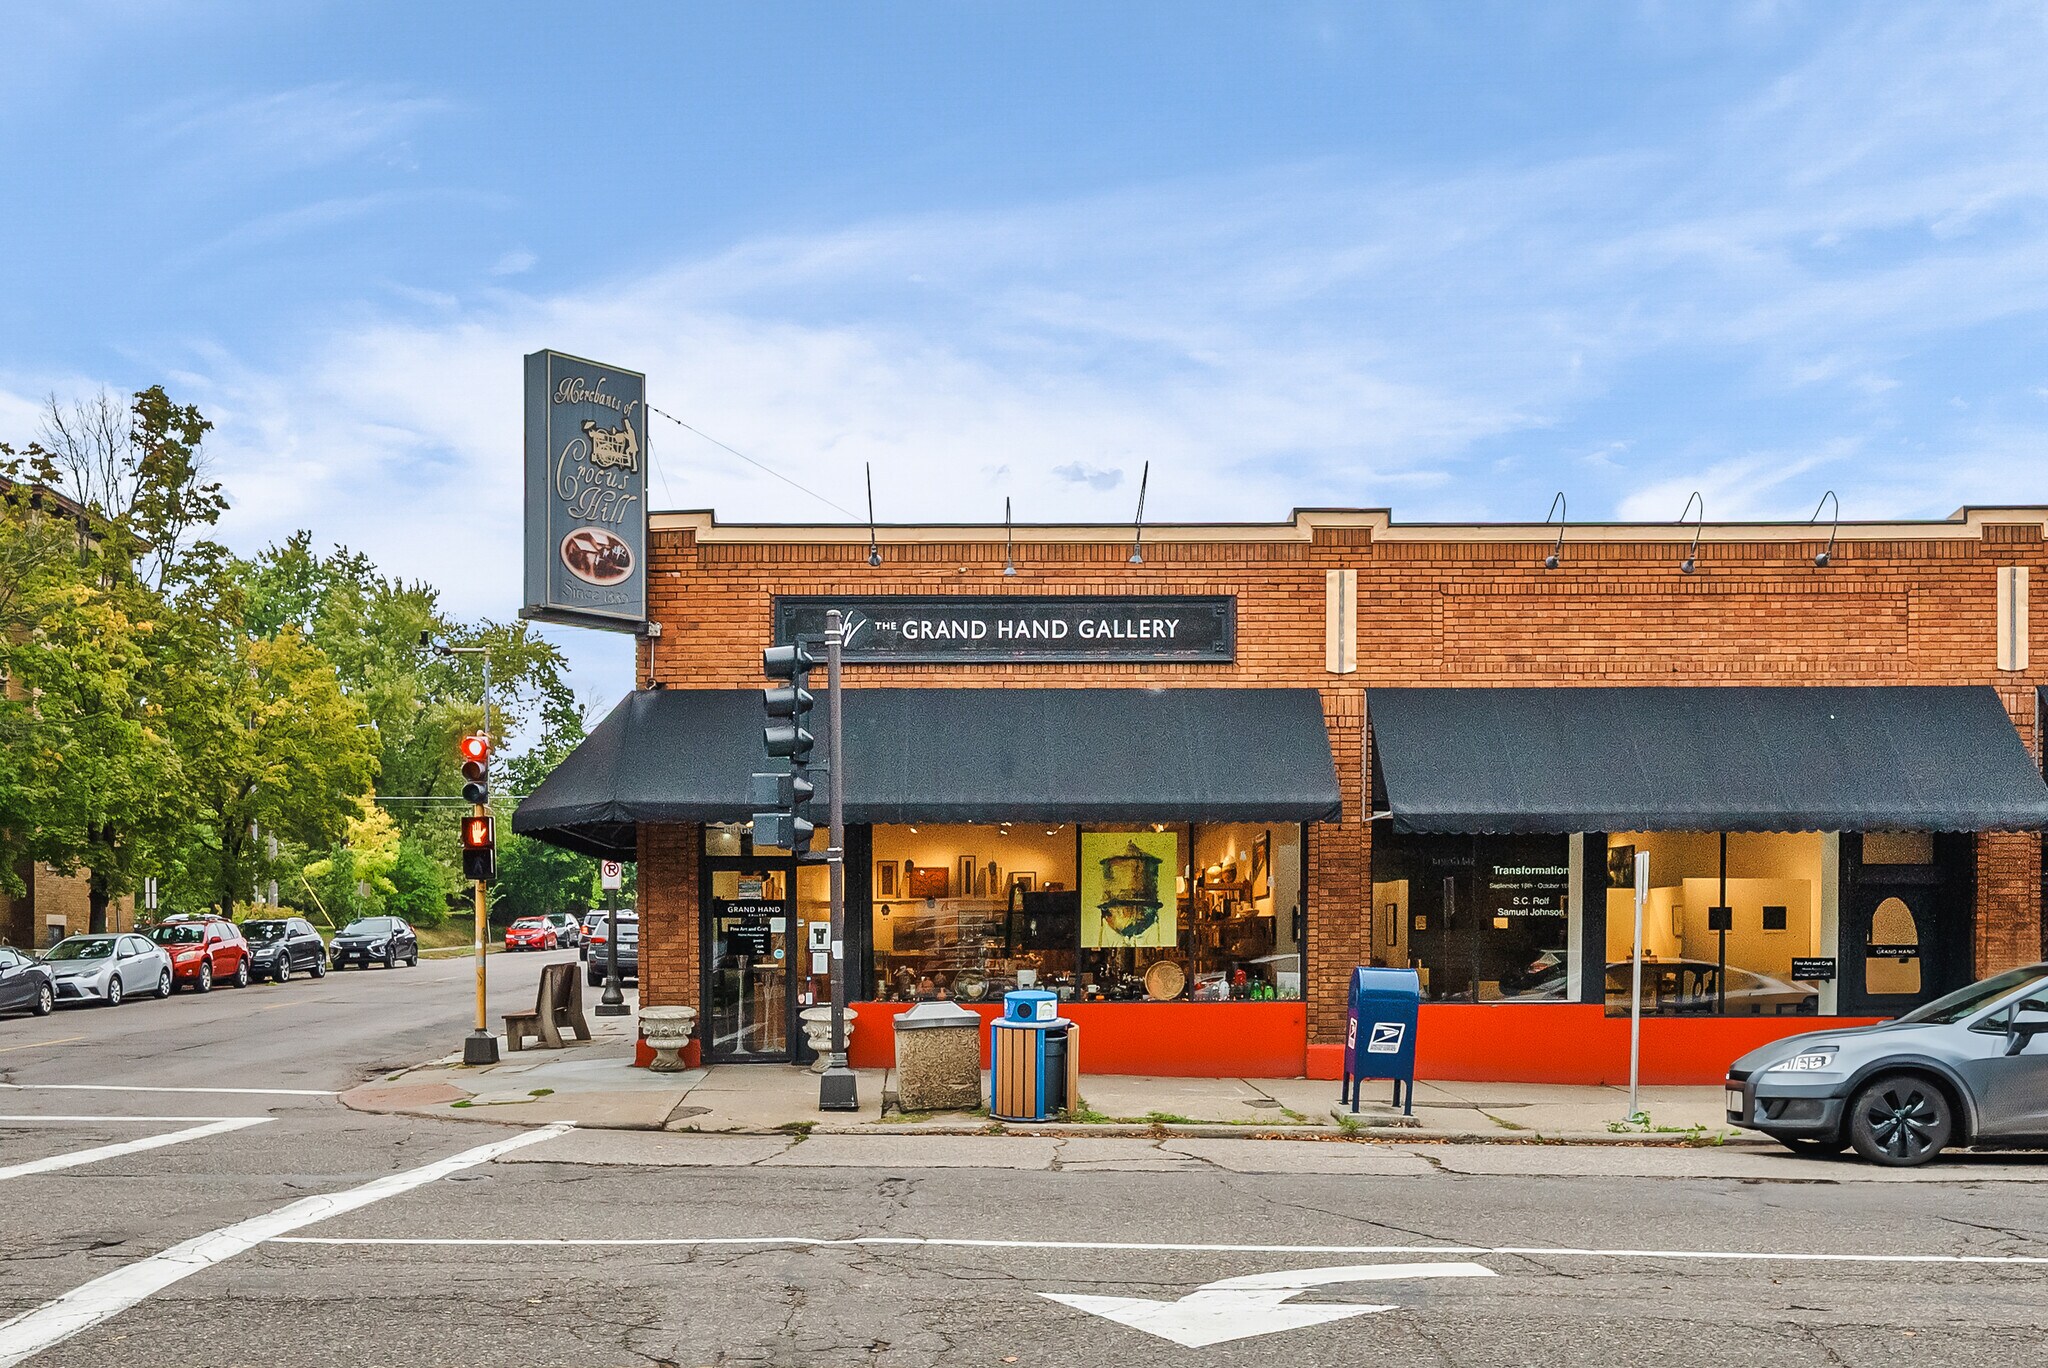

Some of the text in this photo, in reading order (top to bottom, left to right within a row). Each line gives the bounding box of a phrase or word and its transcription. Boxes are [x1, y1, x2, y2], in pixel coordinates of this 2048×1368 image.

[553, 377, 639, 418] Merchants of
[556, 438, 629, 501] Crocus
[567, 486, 638, 524] Hill
[561, 579, 600, 602] Since
[874, 618, 1180, 640] THE GRAND HAND GALLERY
[1497, 907, 1565, 917] Samuel Johnson
[1512, 896, 1531, 906] S.C.
